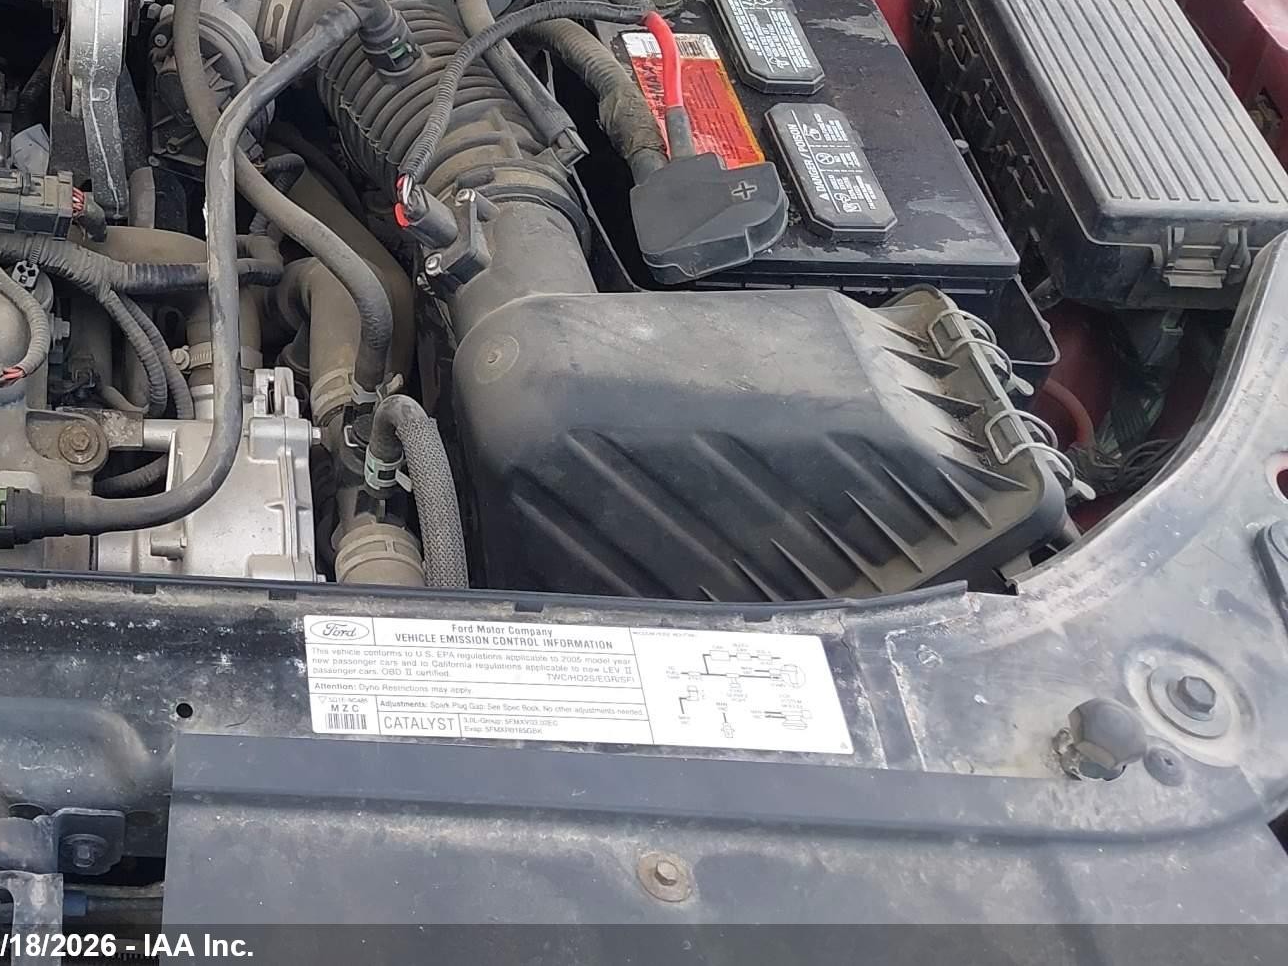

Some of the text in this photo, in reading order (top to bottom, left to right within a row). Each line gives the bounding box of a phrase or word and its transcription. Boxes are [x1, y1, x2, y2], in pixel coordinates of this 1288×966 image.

[323, 622, 356, 637] Ford
[452, 624, 553, 638] Ford Motor Company
[395, 634, 613, 649] VEHICLE EMISSION CONTROL INFORMATION
[457, 652, 502, 660] regulations
[506, 654, 548, 664] applicable
[332, 659, 376, 668] passenger
[432, 660, 472, 669] California
[476, 662, 522, 671] regulations
[526, 664, 569, 673] applicable
[314, 682, 356, 690] Attention:
[382, 684, 429, 692] Restrictions
[380, 700, 426, 708] Adjustments:
[503, 704, 520, 712] Spec
[384, 716, 454, 730] CATALYST
